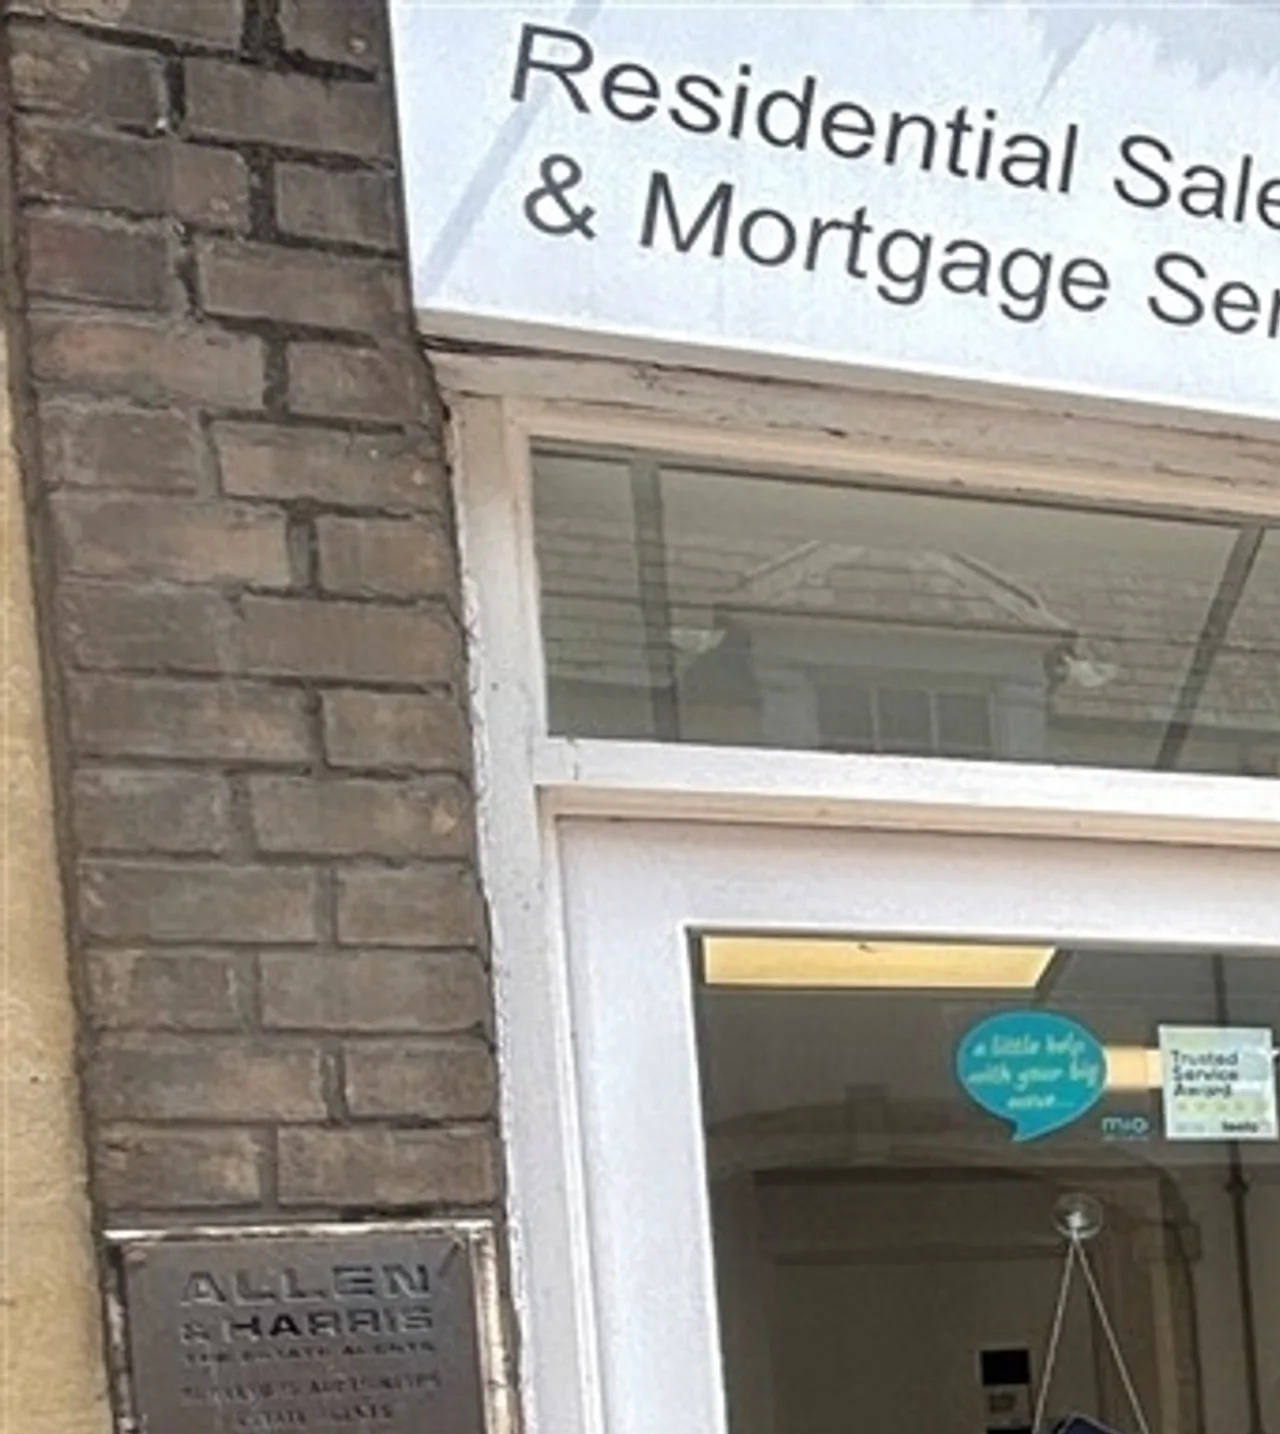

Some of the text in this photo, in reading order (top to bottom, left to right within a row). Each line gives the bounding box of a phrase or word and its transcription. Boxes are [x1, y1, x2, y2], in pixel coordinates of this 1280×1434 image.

[509, 22, 1078, 196] Residential
[522, 153, 598, 242] &
[638, 171, 1111, 324] Mortgage
[1170, 1049, 1239, 1067] Trusted
[1173, 1065, 1239, 1081] Service
[182, 1263, 431, 1304] ALLEN
[220, 1304, 434, 1343] HARRIS
